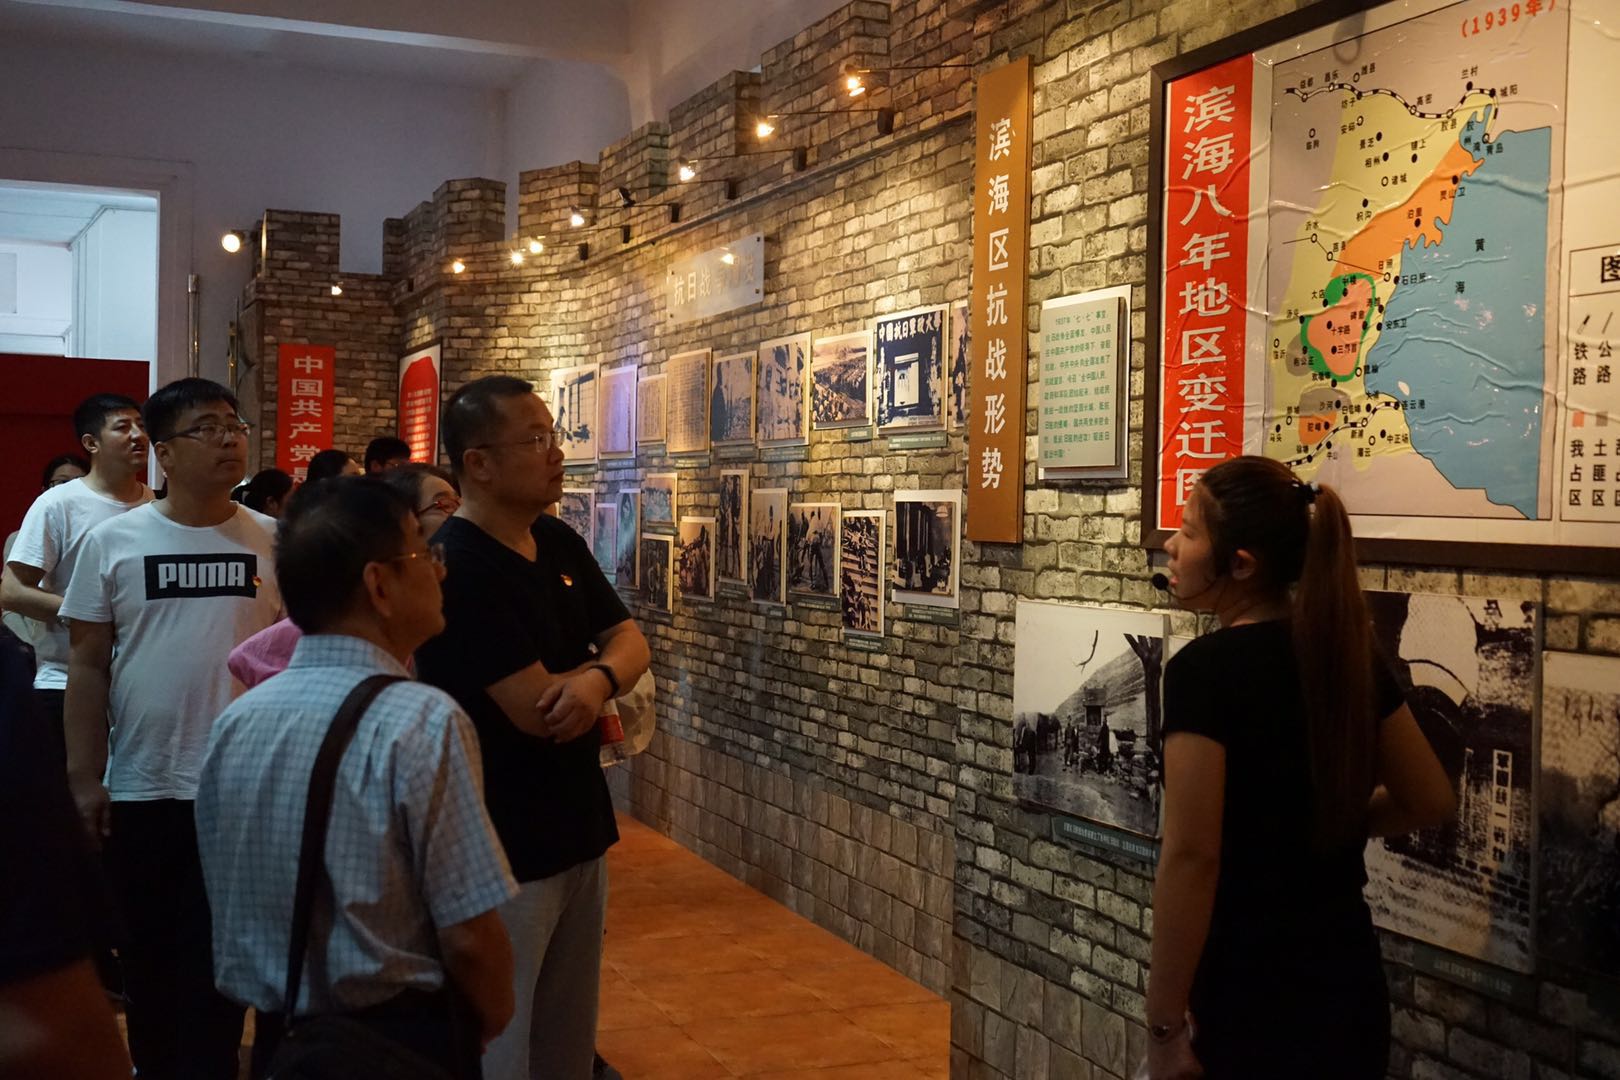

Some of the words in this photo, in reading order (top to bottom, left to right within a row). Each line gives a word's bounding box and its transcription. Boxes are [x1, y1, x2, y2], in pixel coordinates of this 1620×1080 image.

[982, 118, 1012, 488] 滨海区抗战形势
[1573, 342, 1588, 385] 铁路
[1597, 341, 1612, 384] 公路
[1569, 440, 1584, 506] 我占区
[158, 562, 246, 589] PUMA
